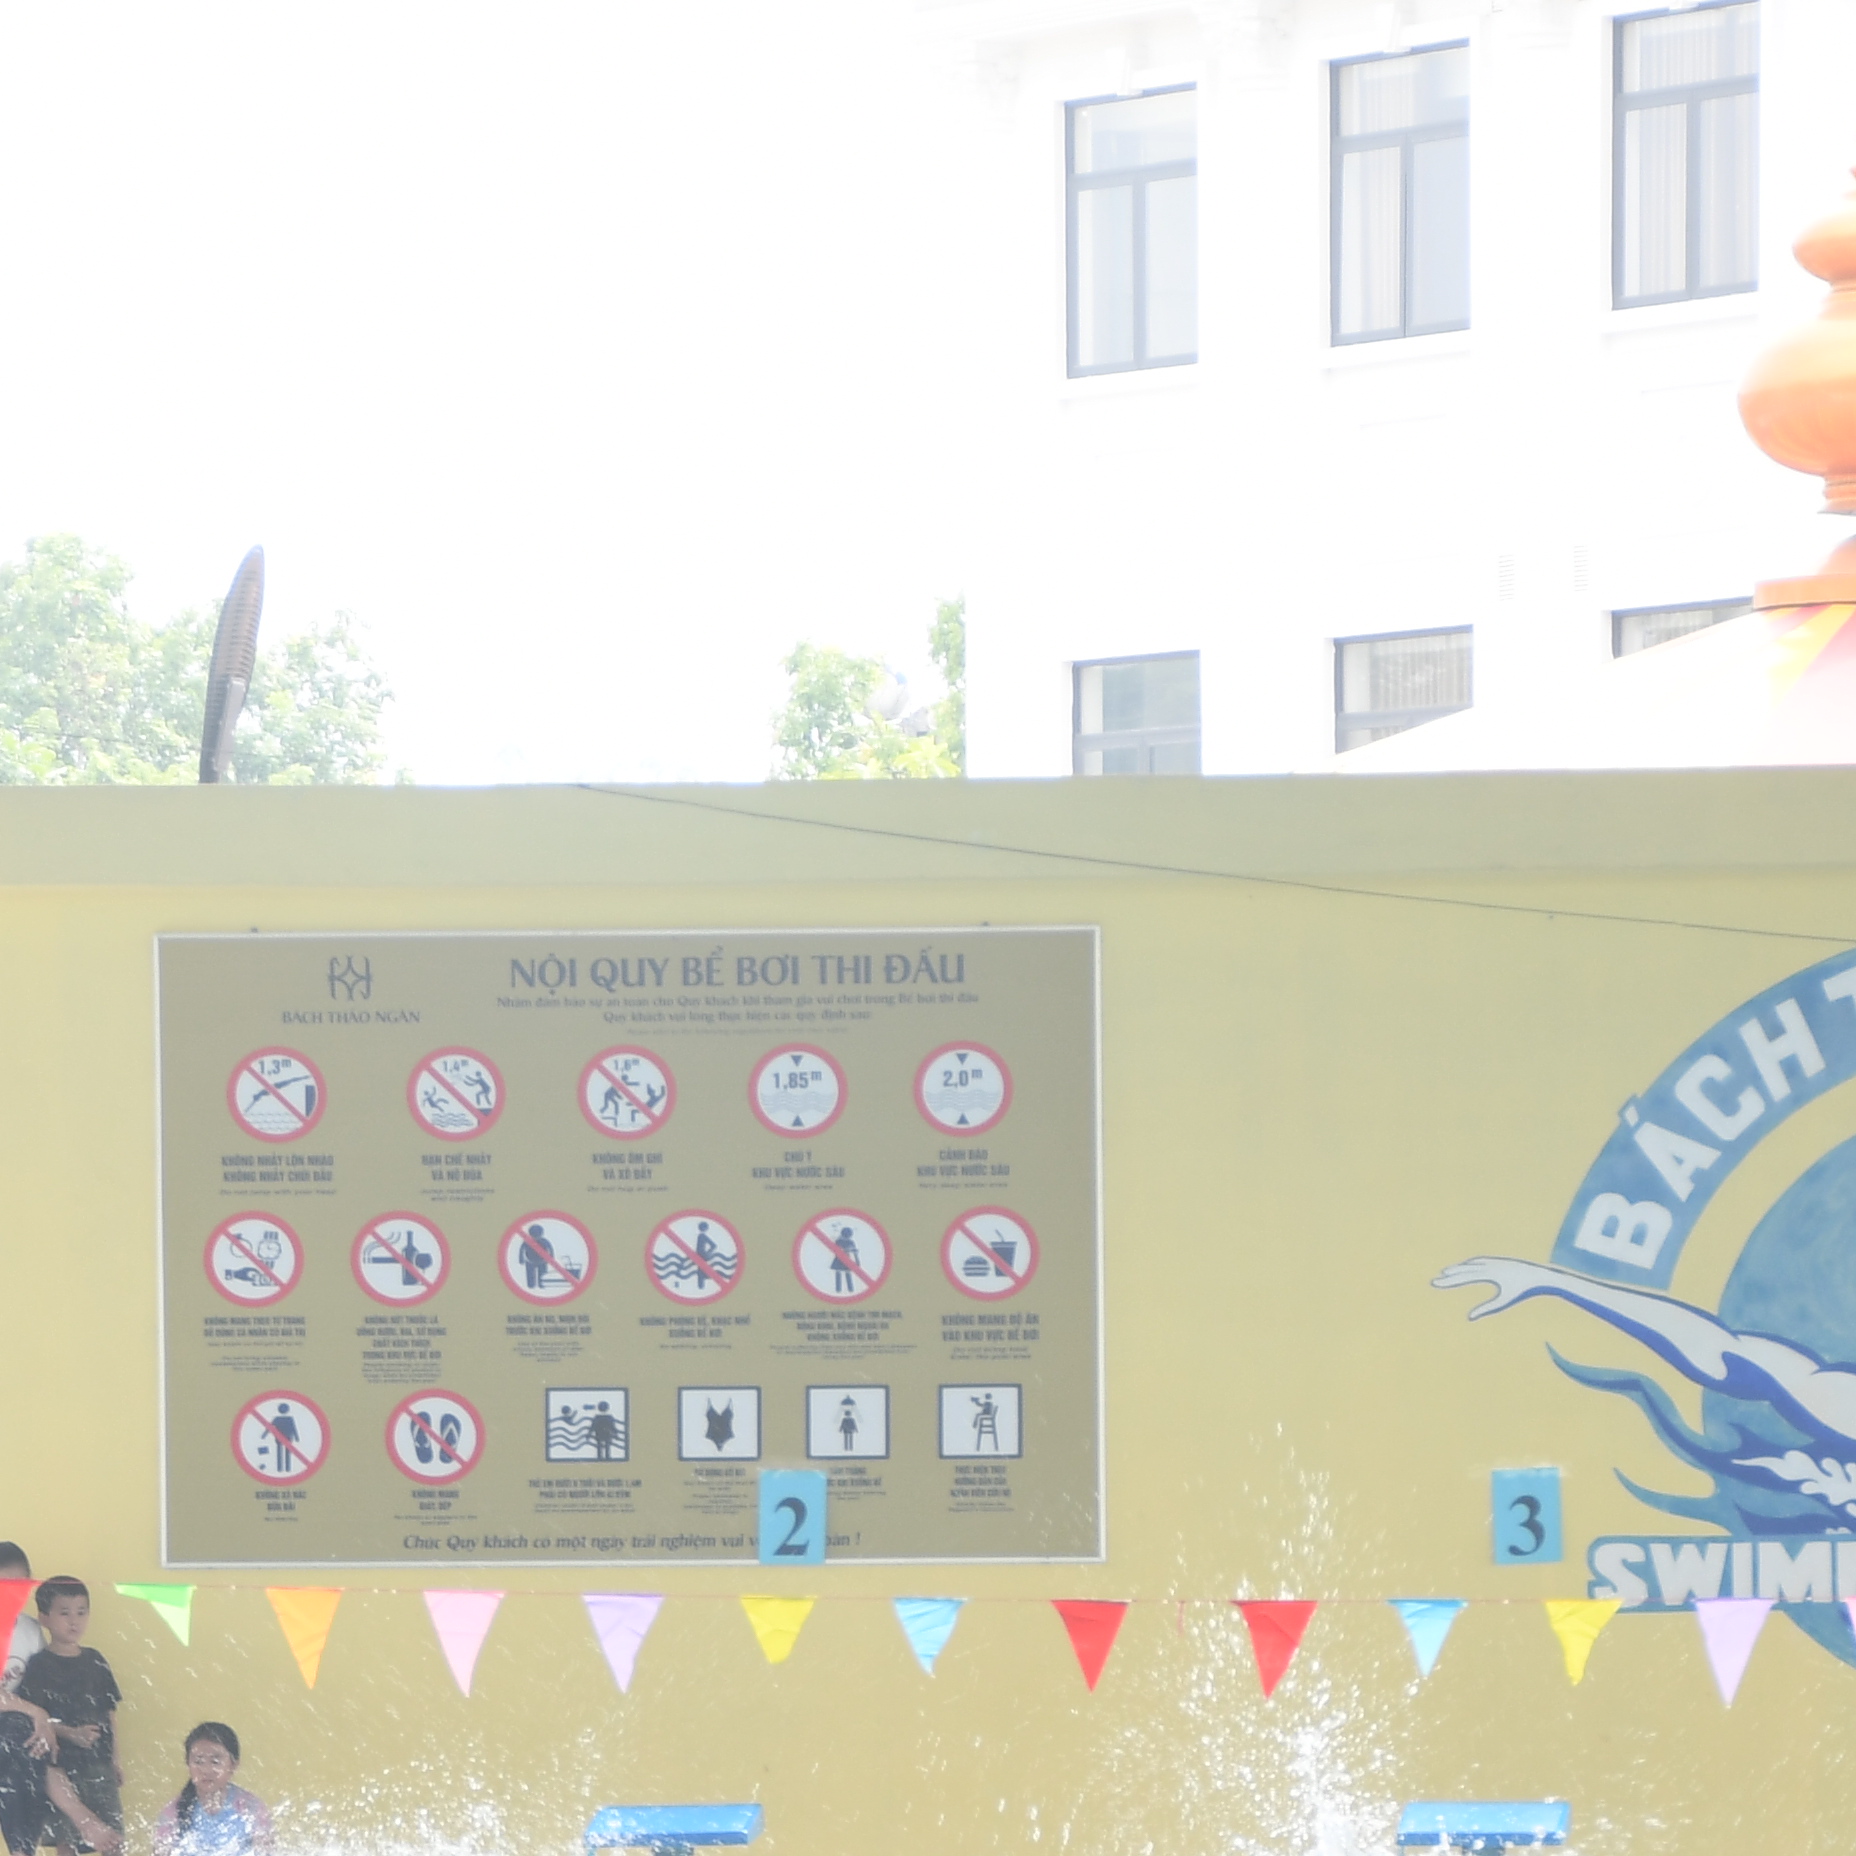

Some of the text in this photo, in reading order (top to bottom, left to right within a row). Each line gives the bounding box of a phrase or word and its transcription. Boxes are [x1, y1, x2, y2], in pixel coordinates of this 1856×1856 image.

[511, 945, 965, 995] NỘI QUY BỂ BƠI THI ĐẤU
[1574, 1000, 1826, 1273] BÁCH
[773, 1496, 810, 1557] 2
[1508, 1495, 1545, 1556] 3
